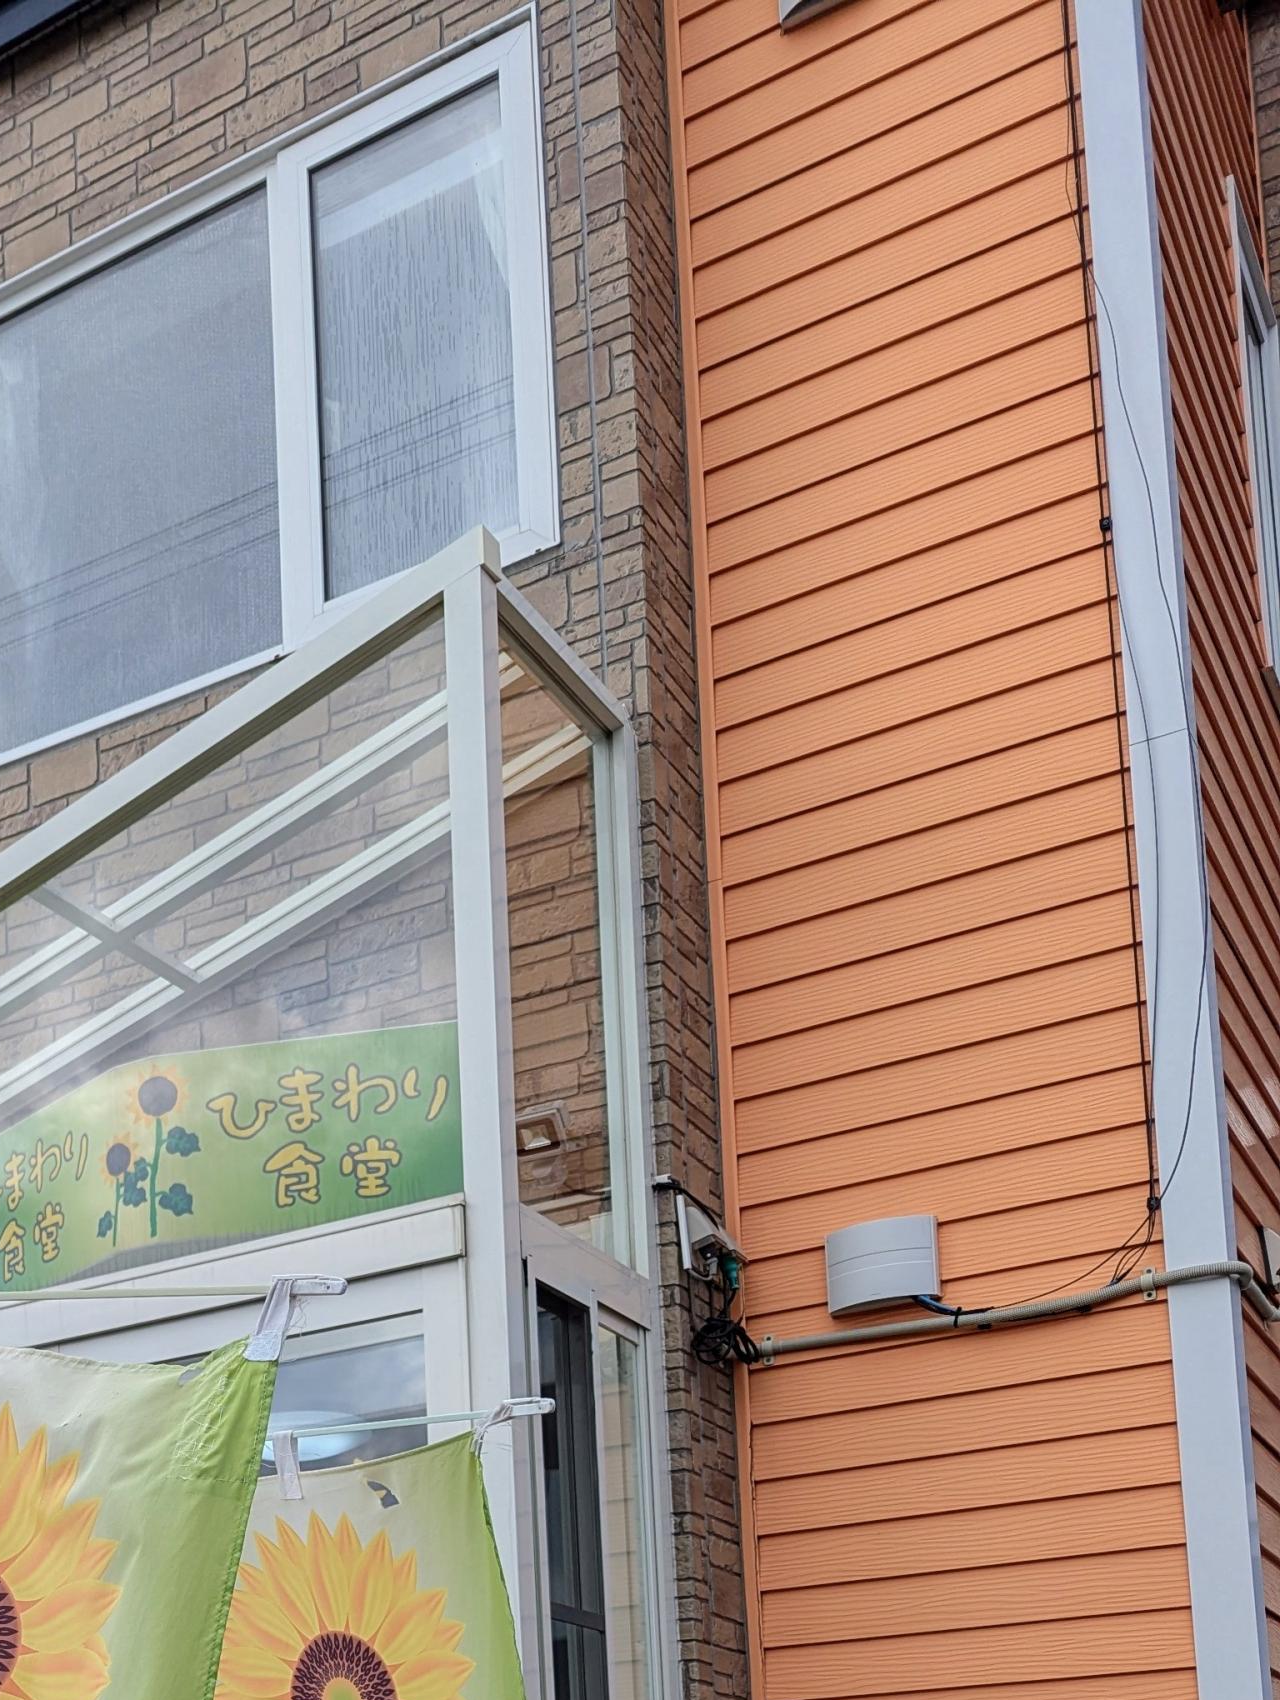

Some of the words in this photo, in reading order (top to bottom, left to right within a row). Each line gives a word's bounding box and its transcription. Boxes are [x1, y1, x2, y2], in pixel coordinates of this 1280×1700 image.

[206, 1063, 449, 1140] ひまわり
[263, 1135, 402, 1207] 食堂
